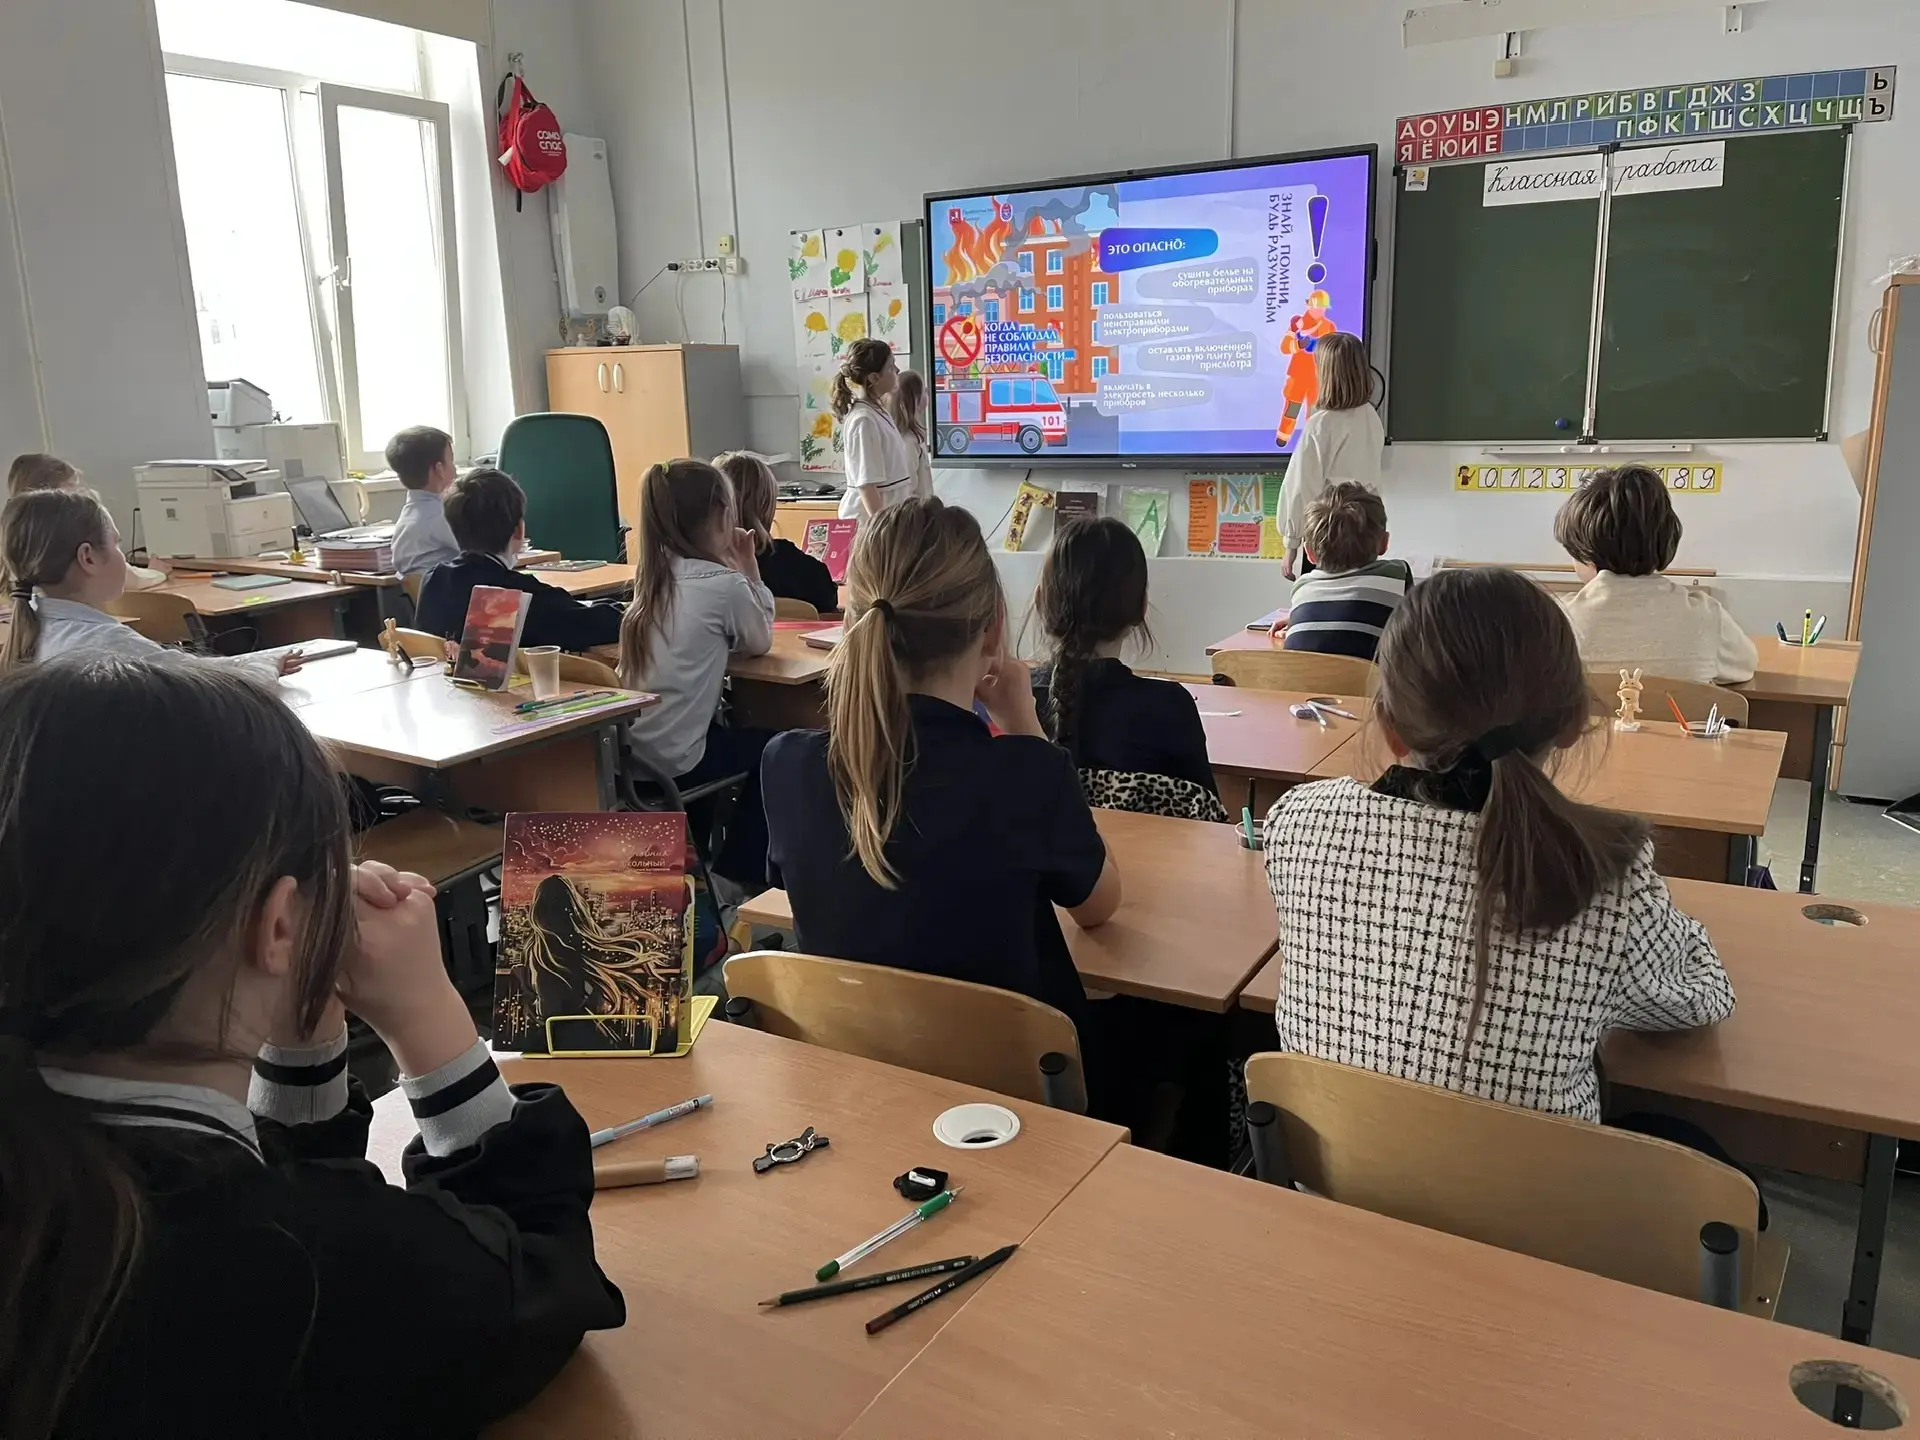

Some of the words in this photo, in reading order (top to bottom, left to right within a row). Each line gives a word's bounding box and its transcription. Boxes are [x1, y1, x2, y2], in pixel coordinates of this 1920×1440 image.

[1400, 122, 1416, 139] А
[1420, 119, 1437, 137] О
[1442, 114, 1456, 134] У
[1463, 112, 1479, 132] Ы
[1485, 109, 1499, 129] Э
[1506, 107, 1521, 127] Н
[1526, 104, 1546, 125] М
[1550, 101, 1566, 122] Л
[1576, 99, 1590, 118] Р
[1597, 94, 1615, 115] Й
[1619, 95, 1633, 113] Б
[1643, 93, 1656, 111] В
[1668, 89, 1682, 108] Г
[1687, 87, 1708, 109] Д
[1712, 85, 1734, 104] Ж
[1740, 82, 1756, 101] З
[1873, 72, 1888, 91] Ь
[1400, 144, 1412, 161] Я
[1422, 139, 1432, 159] Ё
[1440, 139, 1458, 157] Ю
[1462, 136, 1477, 155] И
[1485, 134, 1498, 152] Е
[1616, 119, 1632, 138] П
[1638, 116, 1658, 135] Ф
[1664, 113, 1681, 134] К
[1690, 111, 1705, 131] Т
[1711, 109, 1732, 130] Ш
[1738, 107, 1755, 127] С
[1763, 105, 1780, 125] Х
[1789, 102, 1807, 125] Ц
[1816, 101, 1832, 121] Ч
[1838, 98, 1861, 121] Щ
[1868, 97, 1885, 116] Ъ
[1487, 165, 1598, 193] Классная
[1614, 149, 1719, 193] работа
[1268, 194, 1280, 231] БУДЬ
[1280, 193, 1293, 239] ЗНАЙ,
[1107, 244, 1130, 255] ЭТО
[1132, 239, 1186, 253] ОПАСНО:
[1177, 271, 1211, 281] сушить
[1213, 267, 1240, 276] белье
[1242, 267, 1254, 275] на
[1266, 235, 1279, 323] РАЗУМНЫМ
[1276, 244, 1292, 308] ПОМНИ,
[1172, 276, 1254, 290] обогревательных
[1207, 284, 1254, 295] приборах
[1103, 311, 1163, 321] пользоваться
[984, 322, 1016, 332] КОГДА
[1103, 318, 1170, 330] неисправными
[984, 333, 997, 342] НЕ
[999, 331, 1057, 342] СОБЛЮДАЛ
[1103, 325, 1189, 337] электроприборами
[984, 342, 1030, 353] ПРАВИЛА
[1148, 345, 1192, 354] оставлять
[1195, 341, 1252, 352] включенной
[1166, 352, 1203, 364] газовую
[1206, 351, 1232, 362] плиту
[1236, 350, 1251, 359] без
[1200, 359, 1251, 371] присмотра
[1103, 390, 1156, 401] электросеть
[1158, 390, 1205, 398] несколько
[1103, 398, 1146, 409] приборов
[1042, 416, 1060, 426] 101
[1485, 468, 1498, 488] 0
[1510, 467, 1521, 488] 1
[1528, 468, 1544, 488] 2
[1551, 468, 1567, 488] 3
[1674, 467, 1689, 489] 8
[1699, 467, 1716, 489] 9
